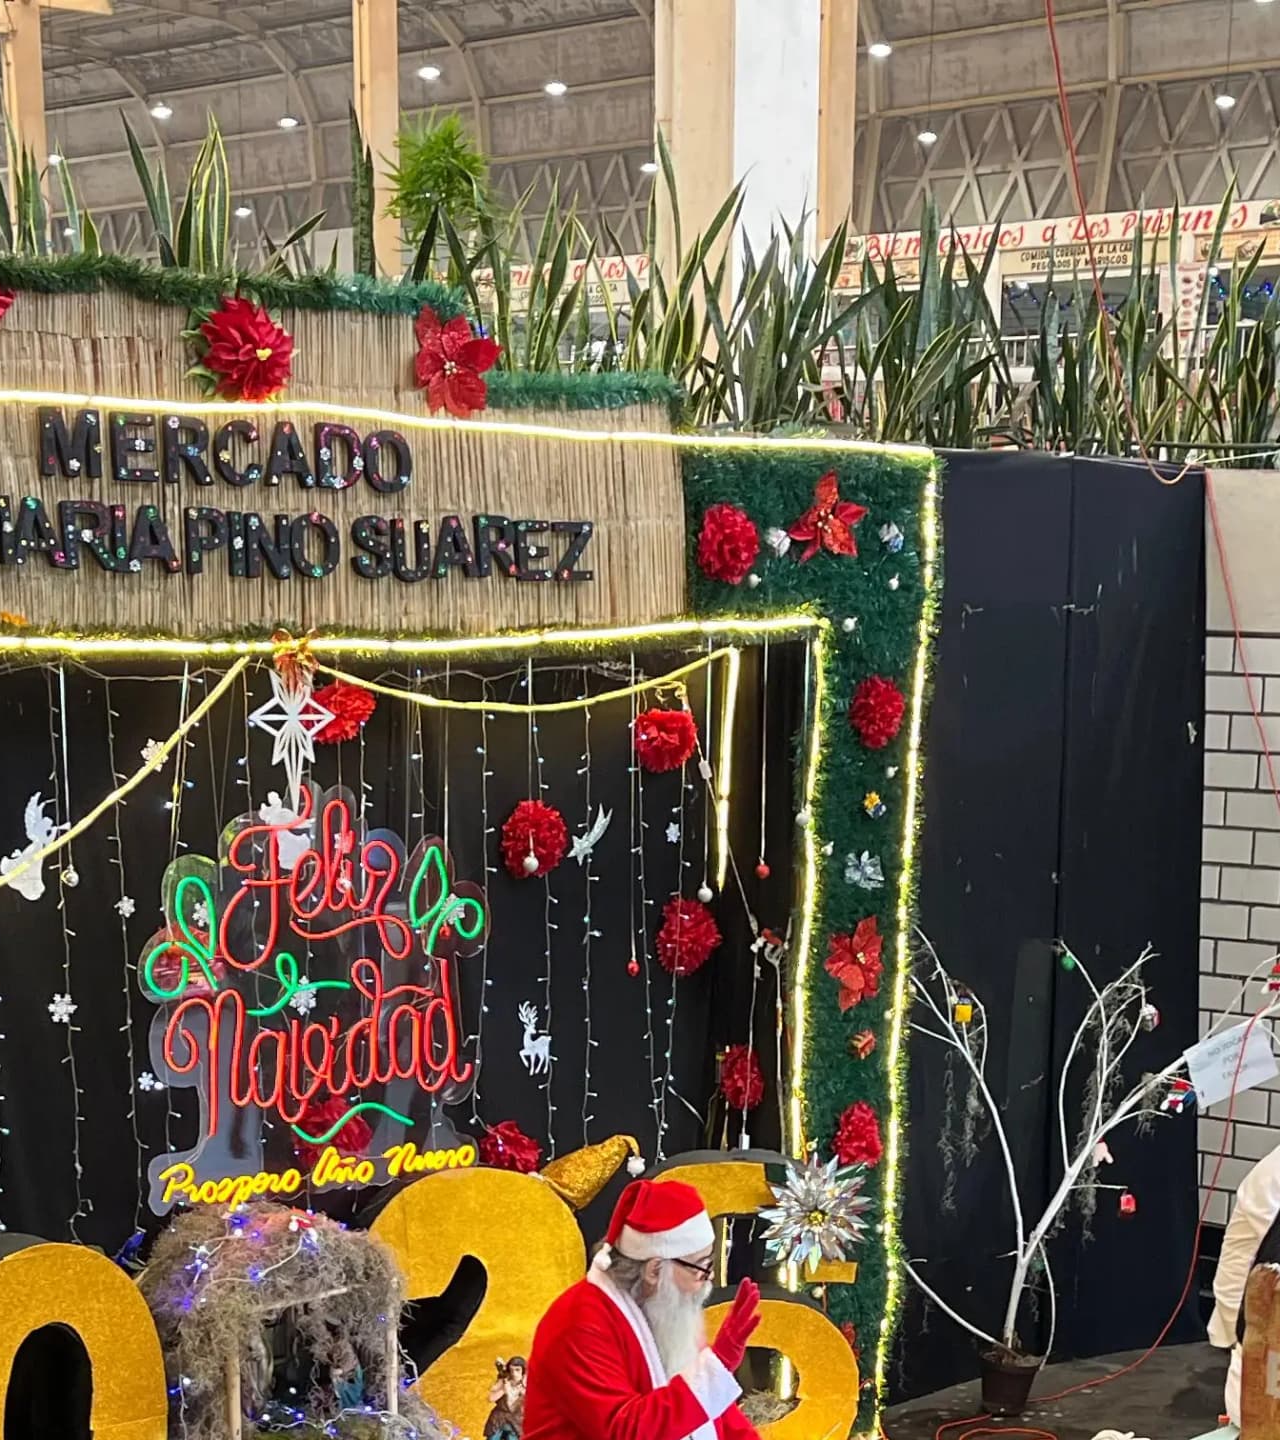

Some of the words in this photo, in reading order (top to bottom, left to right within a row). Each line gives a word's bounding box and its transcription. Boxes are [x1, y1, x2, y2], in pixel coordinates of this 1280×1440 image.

[867, 225, 1026, 260] Bienenidos
[1122, 204, 1248, 237] Paisans
[38, 406, 411, 493] MERCADO
[182, 506, 339, 580] PINO
[349, 514, 594, 582] SUAREZ
[220, 784, 413, 969] Feliz
[164, 959, 472, 1137] Navidad
